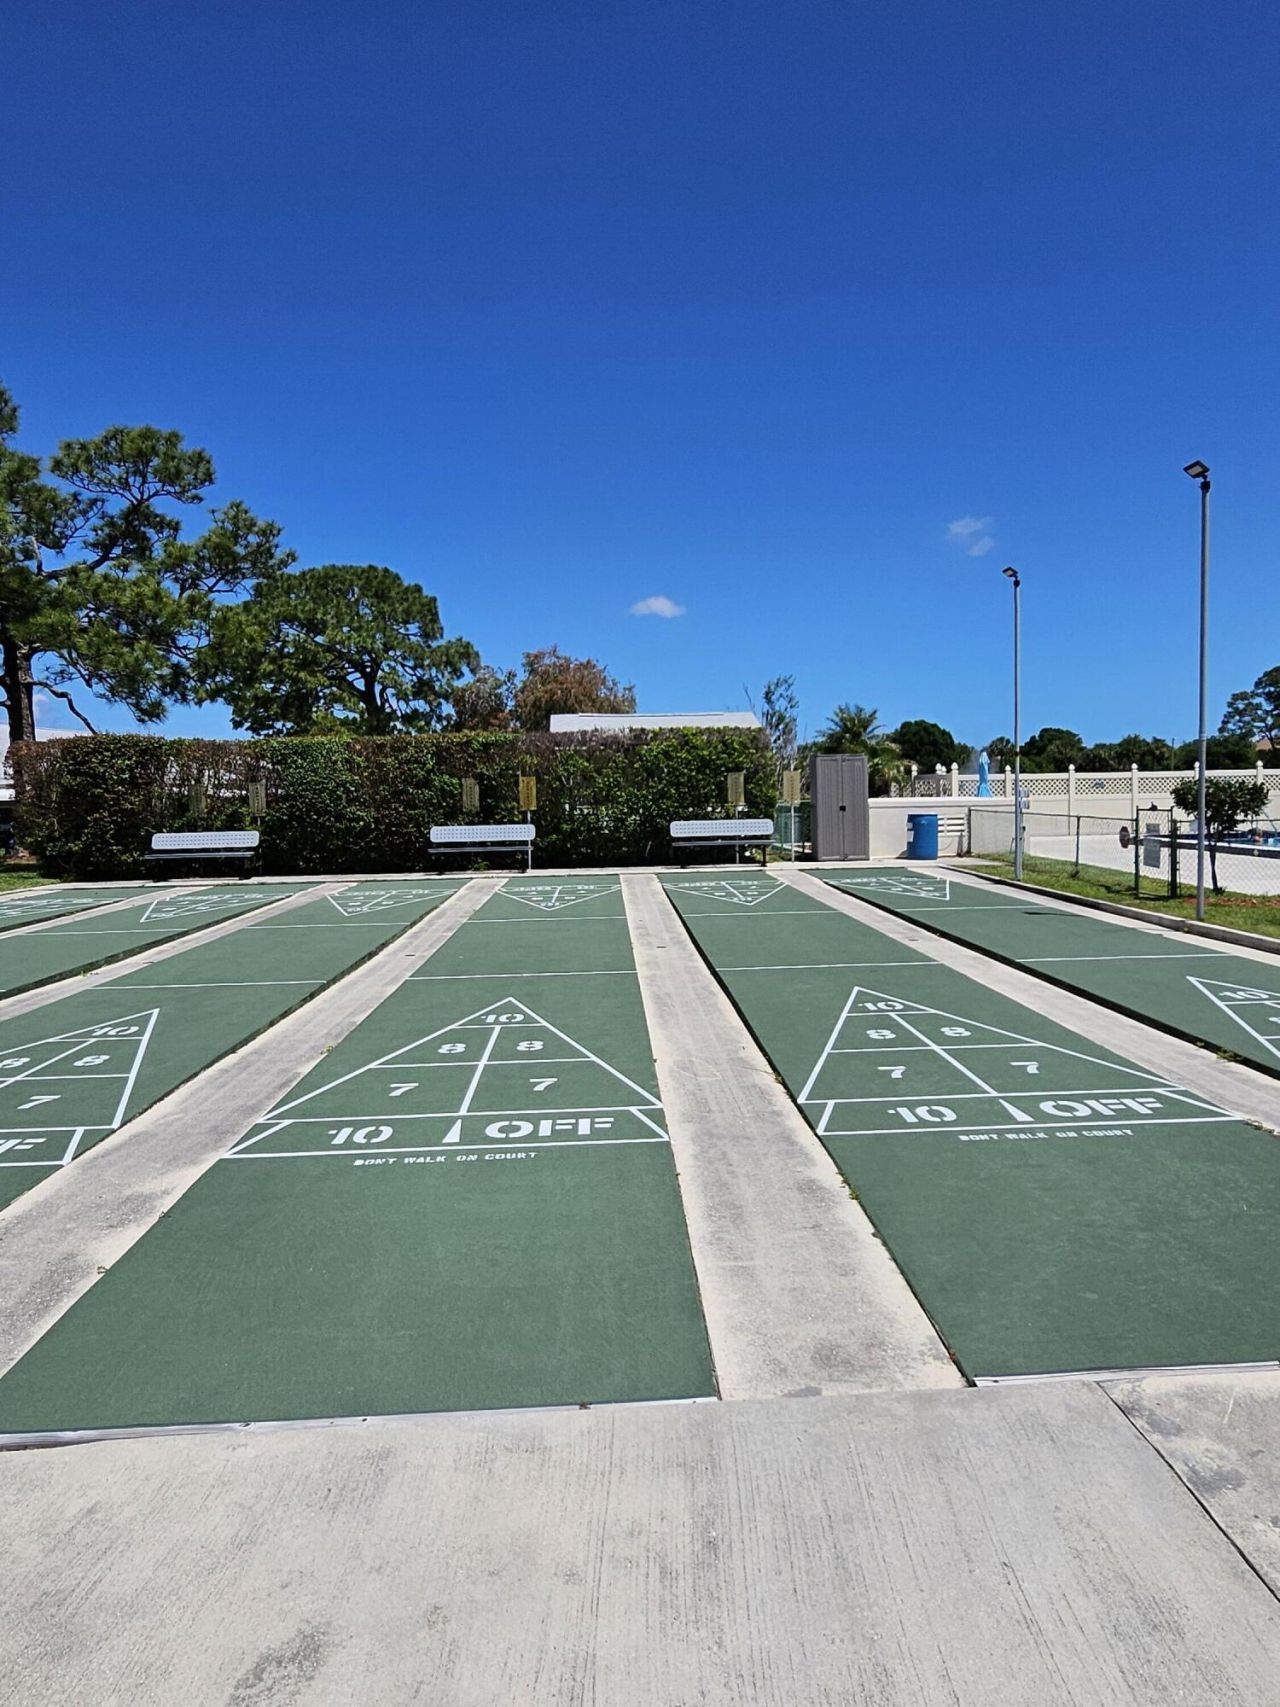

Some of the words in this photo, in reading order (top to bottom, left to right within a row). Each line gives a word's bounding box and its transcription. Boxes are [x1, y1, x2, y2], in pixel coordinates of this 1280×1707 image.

[1218, 991, 1270, 1000] 10
[857, 1001, 905, 1011] 10
[480, 1013, 525, 1024] 10
[91, 1026, 140, 1036] 10
[865, 1029, 897, 1040] 8
[939, 1026, 972, 1037] 8
[437, 1042, 467, 1054] 8
[516, 1040, 545, 1052] 8
[72, 1054, 111, 1067] 8
[876, 1065, 907, 1079] 7
[1009, 1061, 1041, 1074] 7
[388, 1082, 419, 1097] 7
[529, 1077, 559, 1092] 7
[16, 1094, 62, 1110] 7
[886, 1105, 958, 1123] 10
[1038, 1097, 1164, 1118] OFF
[327, 1125, 394, 1145] 10
[484, 1117, 615, 1139] OFF
[1004, 1132, 1049, 1140] WALK
[1082, 1129, 1135, 1138] COURT
[403, 1155, 447, 1164] WALK
[456, 1153, 479, 1162] ON
[484, 1151, 540, 1161] COURT
